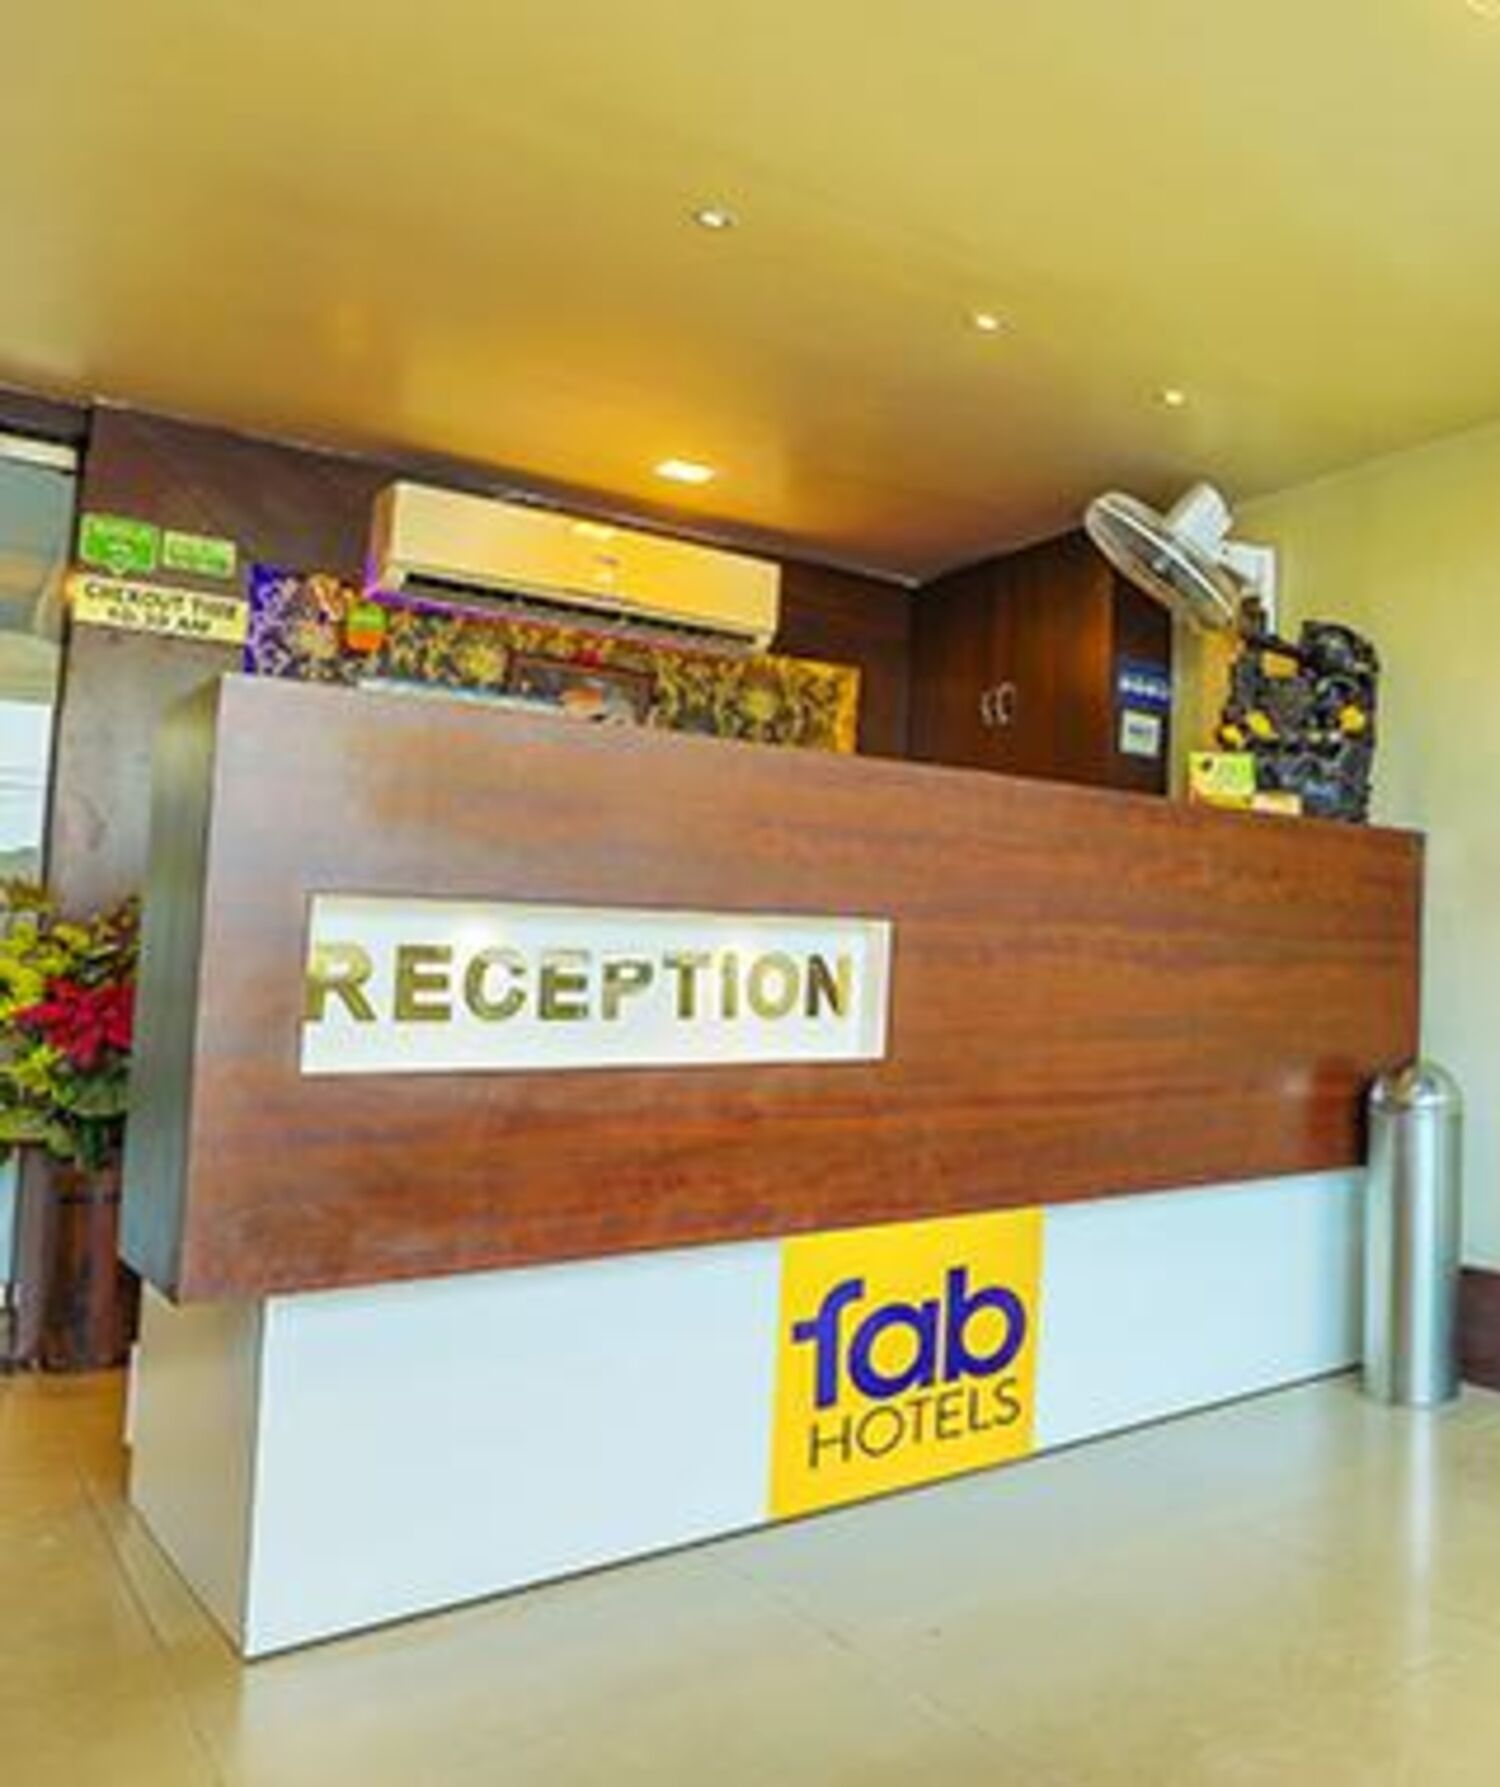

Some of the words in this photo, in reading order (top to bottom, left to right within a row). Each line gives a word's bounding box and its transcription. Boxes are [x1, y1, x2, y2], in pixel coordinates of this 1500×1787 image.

[303, 940, 853, 1023] RECEPTION
[790, 1264, 1027, 1412] fab
[808, 1376, 1023, 1468] HOTELS
